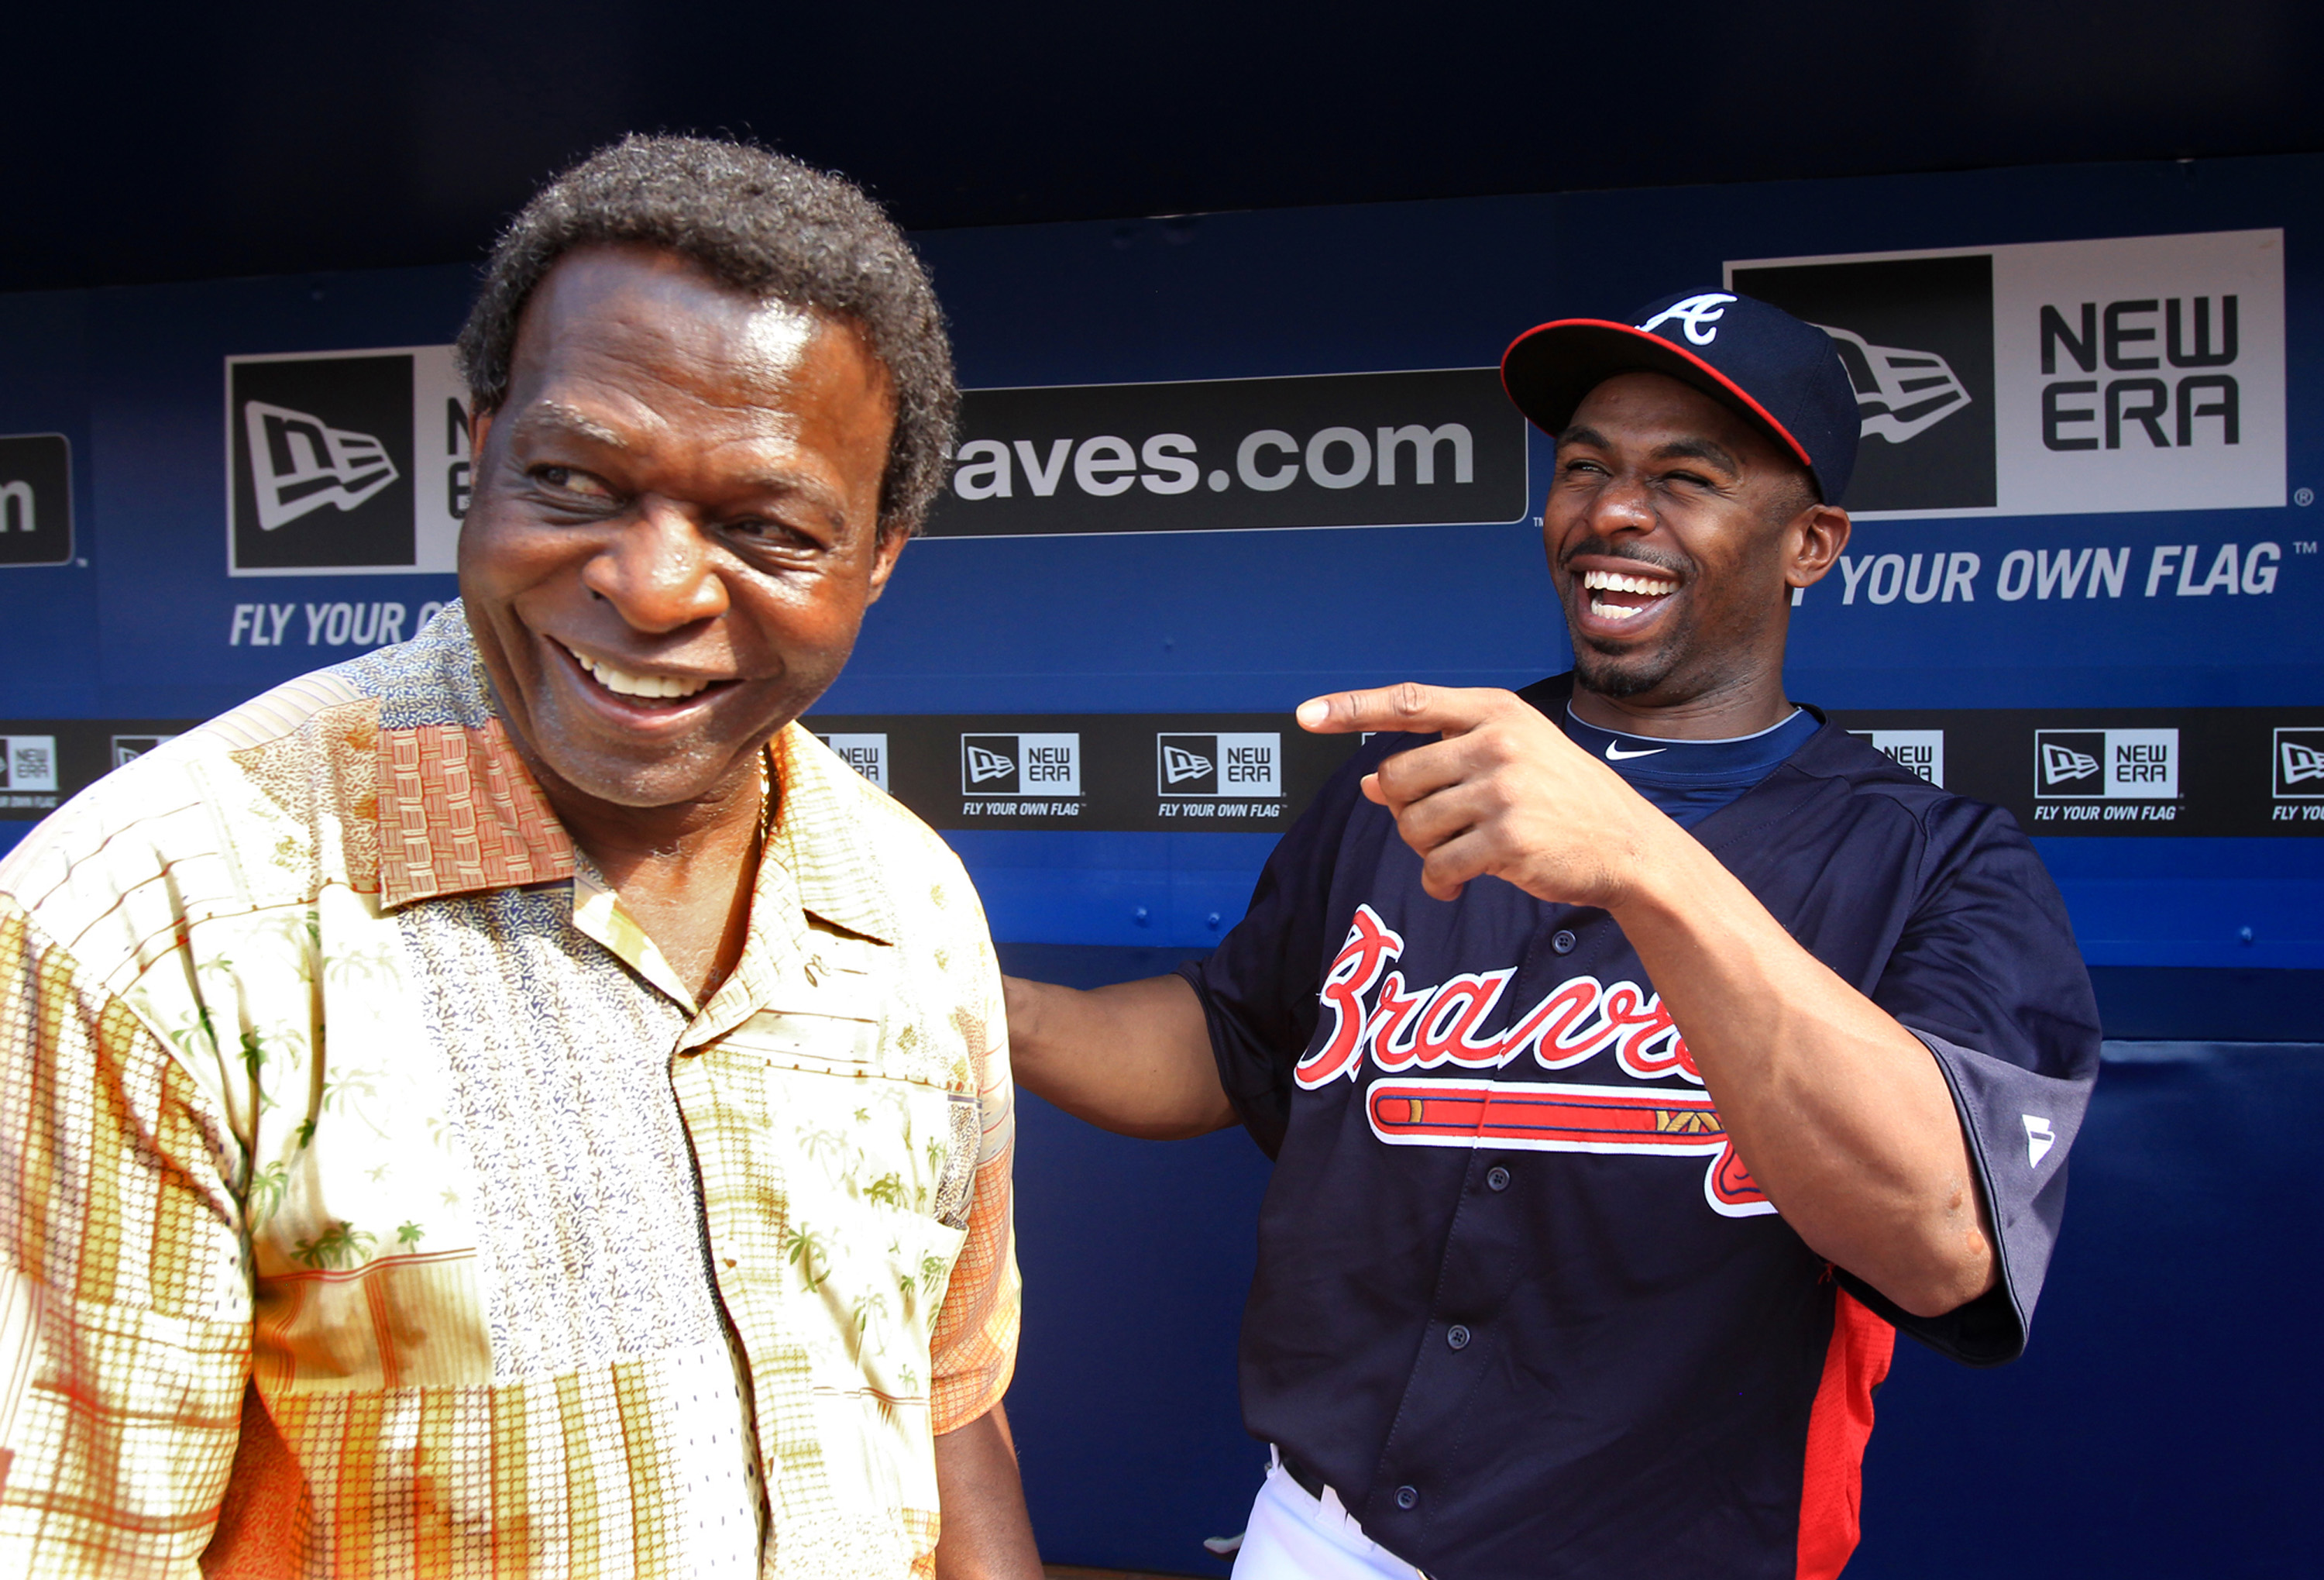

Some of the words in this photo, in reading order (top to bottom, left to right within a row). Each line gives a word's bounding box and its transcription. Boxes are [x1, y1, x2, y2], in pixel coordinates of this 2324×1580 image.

[2040, 294, 2239, 374] NEW
[2041, 374, 2240, 452] ERA
[943, 419, 1473, 501] aves.com
[1839, 550, 1981, 606] YOUR
[1996, 547, 2131, 601] OWN
[2144, 542, 2281, 597] FLAG
[230, 603, 295, 646] FLY
[305, 601, 406, 645] YOUR
[1028, 747, 1070, 764] NEW
[1227, 747, 1270, 764] NEW
[2116, 745, 2167, 763] NEW
[1029, 765, 1071, 782] ERA
[1228, 765, 1271, 783] ERA
[2116, 764, 2167, 783] ERA
[963, 802, 982, 815] FLY
[986, 802, 1018, 815] YOUR
[1019, 802, 1049, 816] OWN
[1050, 803, 1080, 816] FLAG
[1158, 804, 1180, 817] FLY
[1182, 804, 1215, 817] YOUR
[1217, 804, 1248, 817] OWN
[1250, 804, 1281, 818] FLAG
[2034, 806, 2060, 820] FLY
[2063, 806, 2101, 821] YOUR
[2103, 806, 2139, 821] OWN
[2141, 806, 2176, 821] FLAG
[2272, 805, 2299, 821] FLY
[1294, 903, 1705, 1090] Brave
